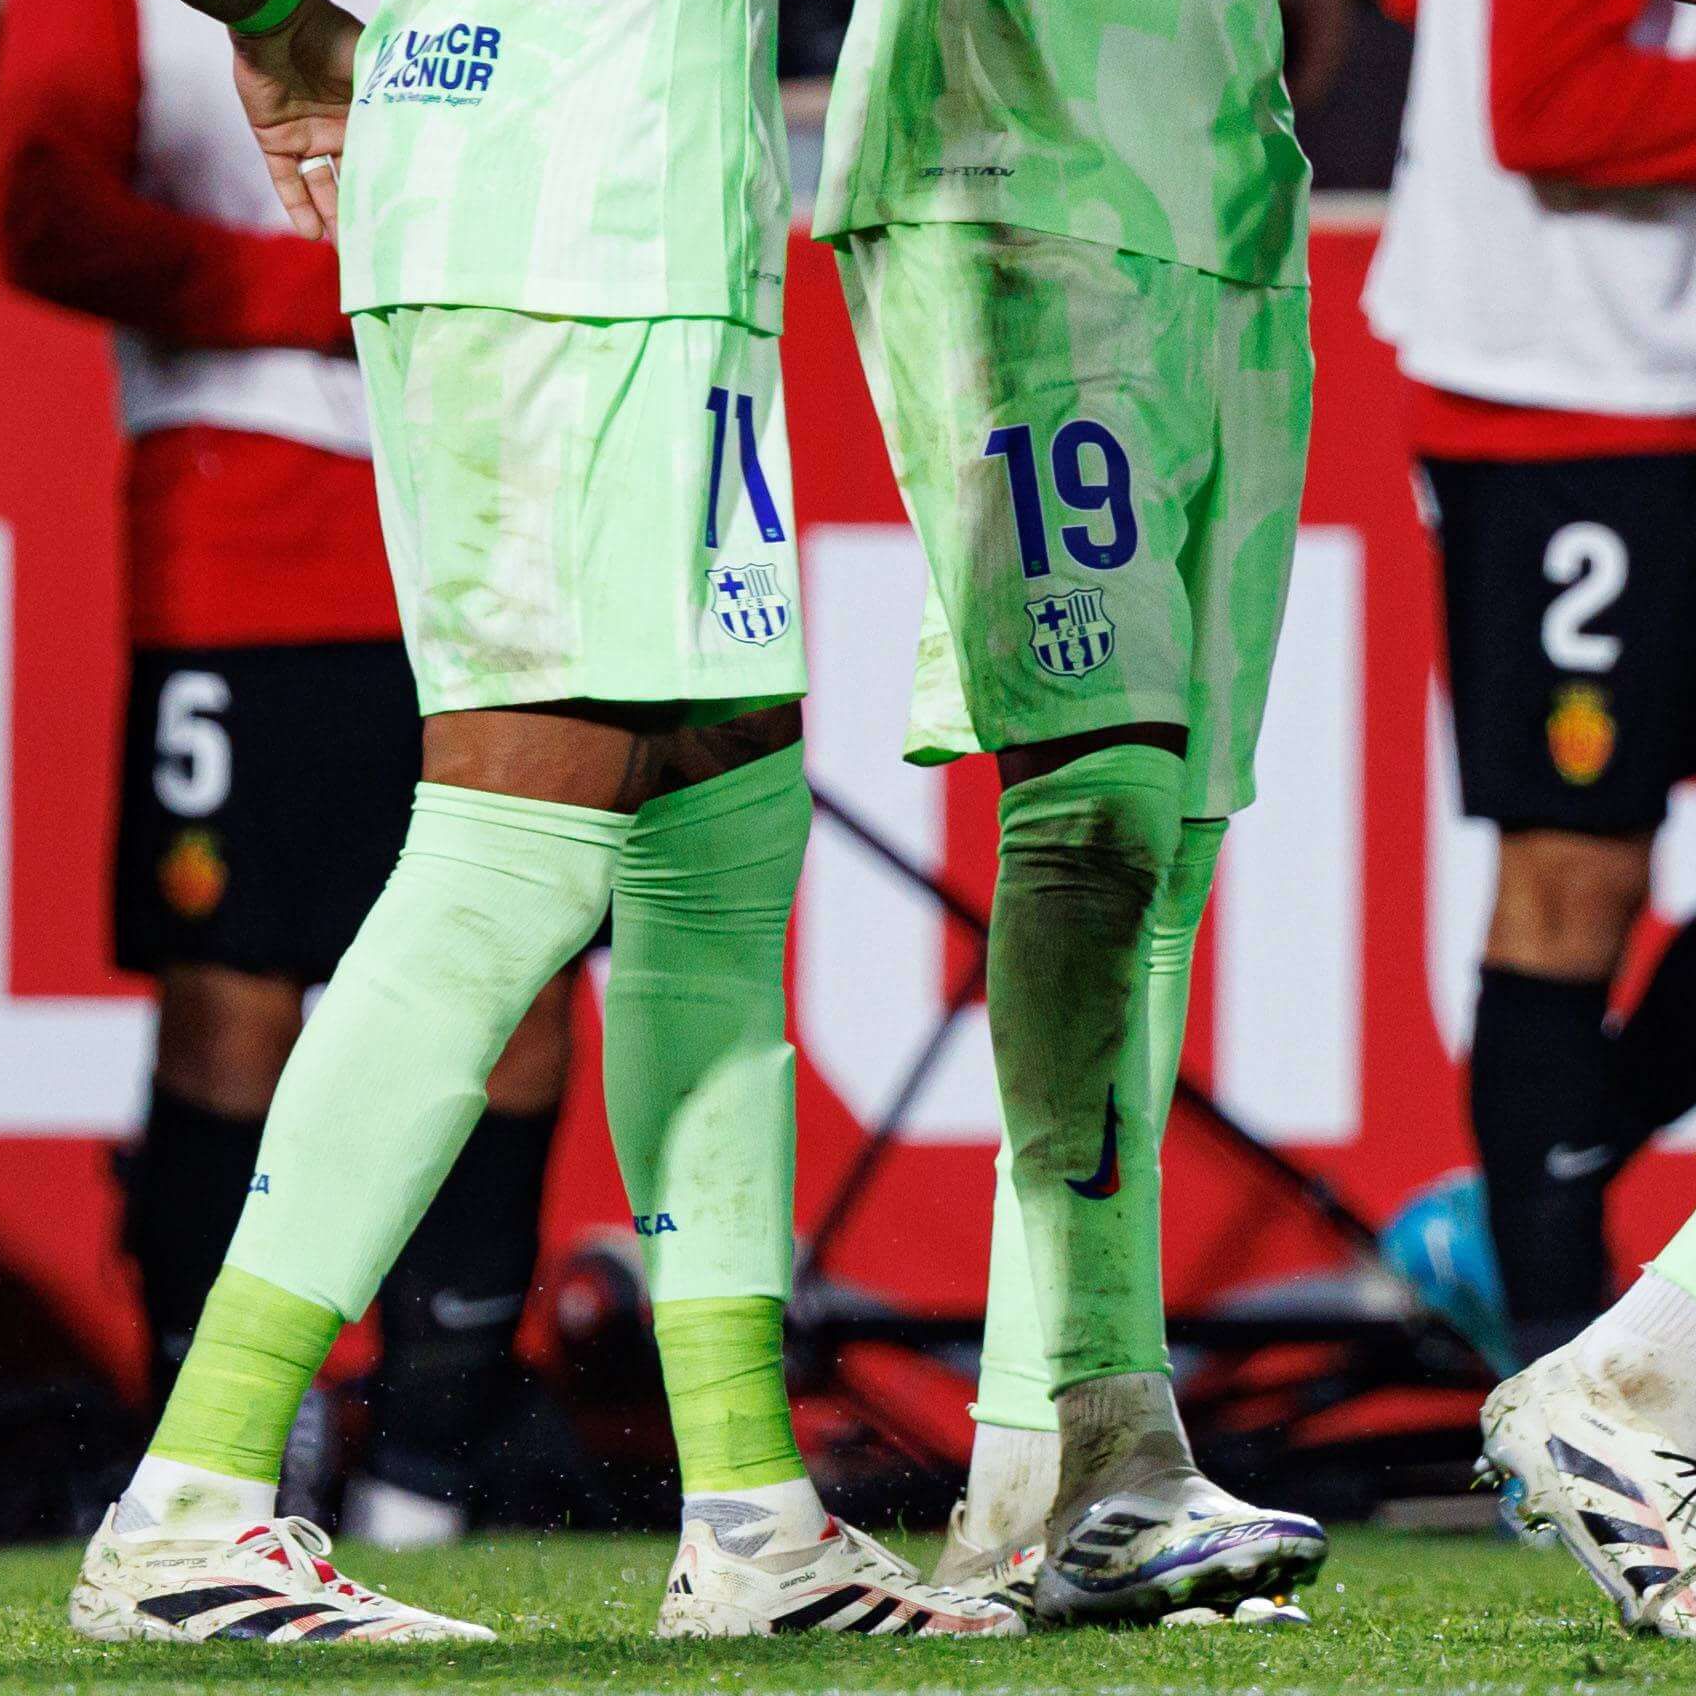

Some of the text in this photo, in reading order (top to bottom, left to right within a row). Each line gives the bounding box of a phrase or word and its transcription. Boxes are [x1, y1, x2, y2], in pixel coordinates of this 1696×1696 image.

[704, 385, 786, 549] 11
[983, 419, 1138, 579] 19
[1541, 519, 1630, 673] 2
[152, 669, 233, 819] 5
